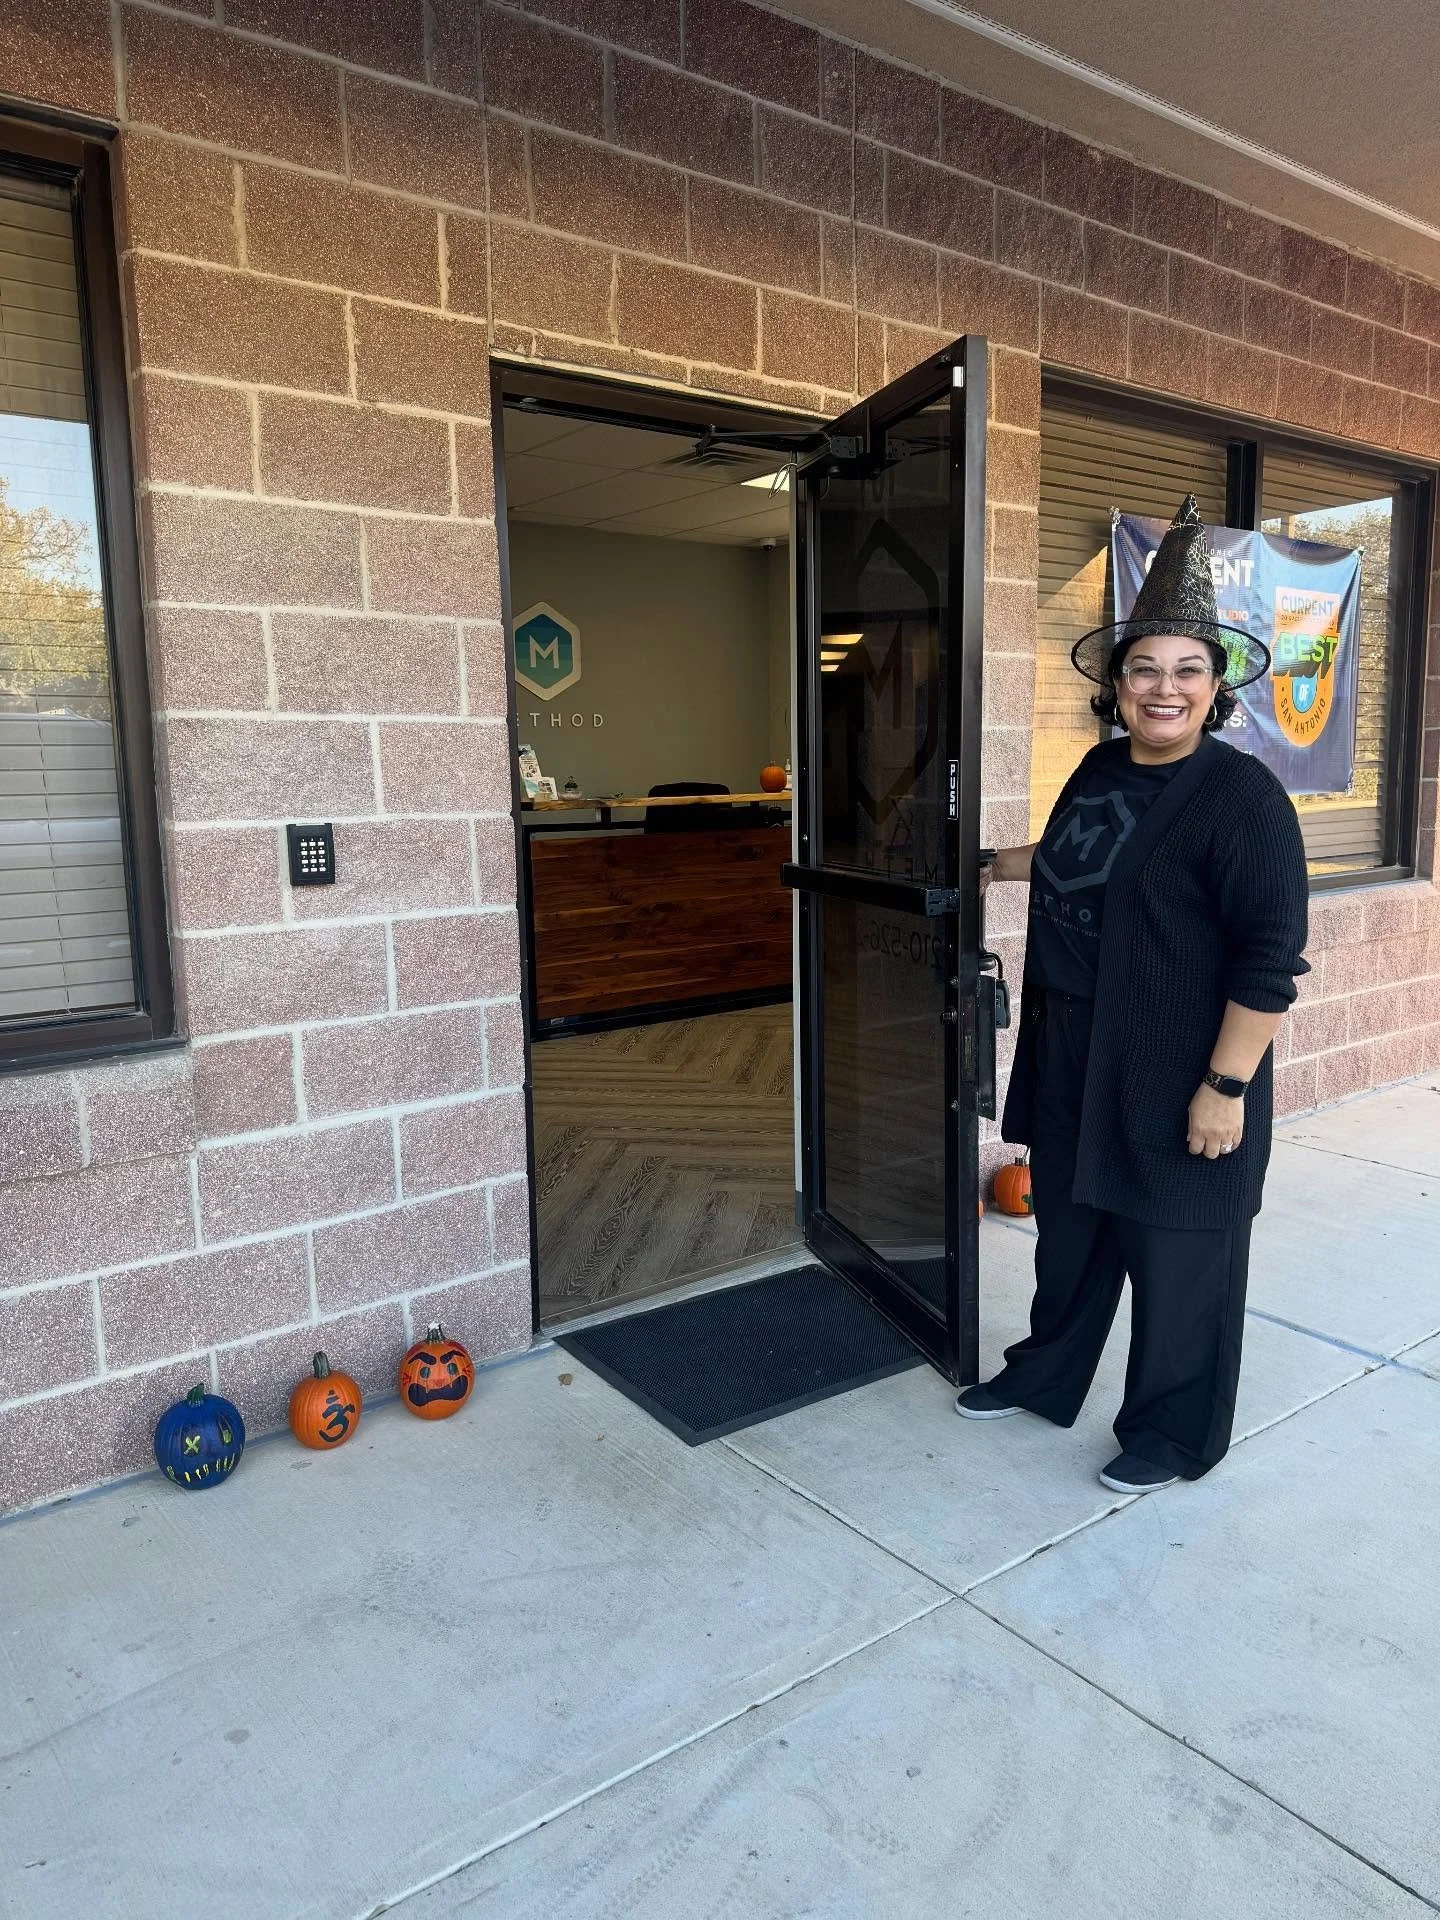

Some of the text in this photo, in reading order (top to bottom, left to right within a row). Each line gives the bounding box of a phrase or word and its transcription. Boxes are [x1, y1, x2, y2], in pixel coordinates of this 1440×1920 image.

[1281, 595, 1335, 616] CURRENT
[529, 635, 560, 669] M
[1279, 632, 1339, 664] BEST
[1299, 683, 1311, 701] OF
[515, 712, 604, 728] THOD
[1280, 697, 1294, 727] SAN
[1294, 697, 1326, 735] ANTONIO
[949, 763, 957, 816] PUSH
[1052, 811, 1110, 862] M
